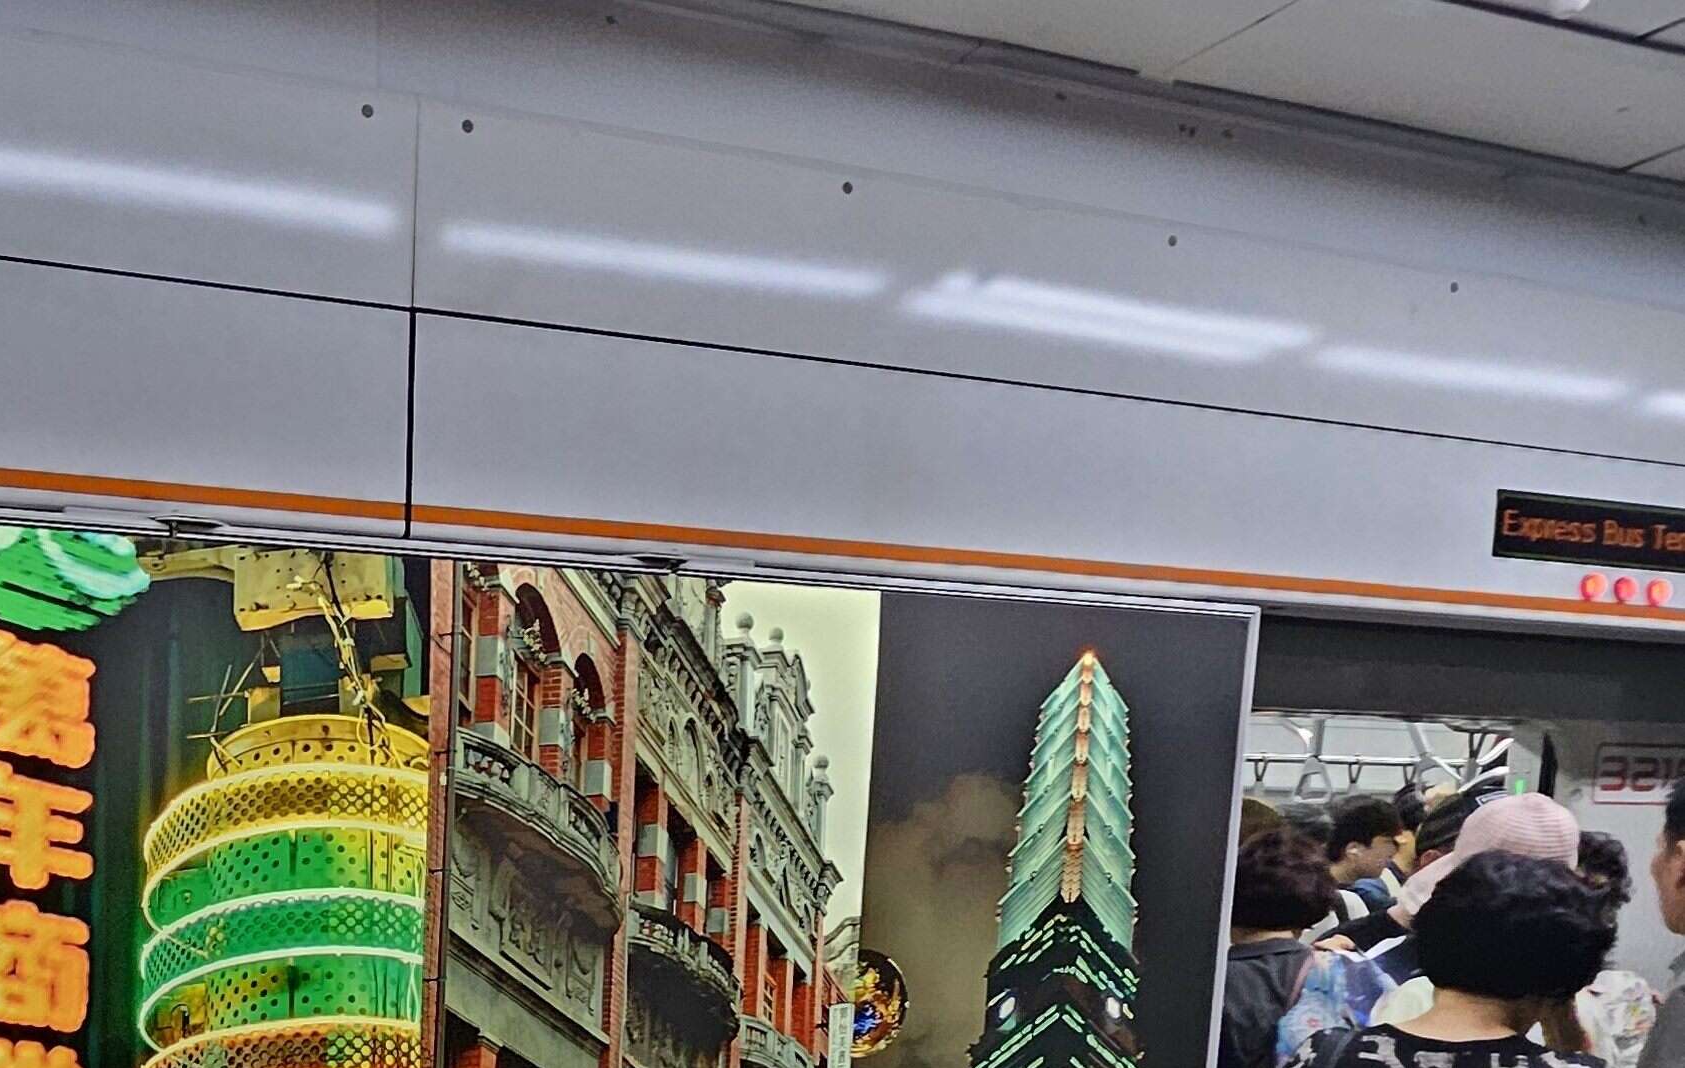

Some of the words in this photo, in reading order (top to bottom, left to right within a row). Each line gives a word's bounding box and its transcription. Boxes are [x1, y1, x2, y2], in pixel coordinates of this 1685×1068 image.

[1502, 509, 1597, 543] Express
[1602, 519, 1644, 549] Bus
[1599, 755, 1685, 792] 321
